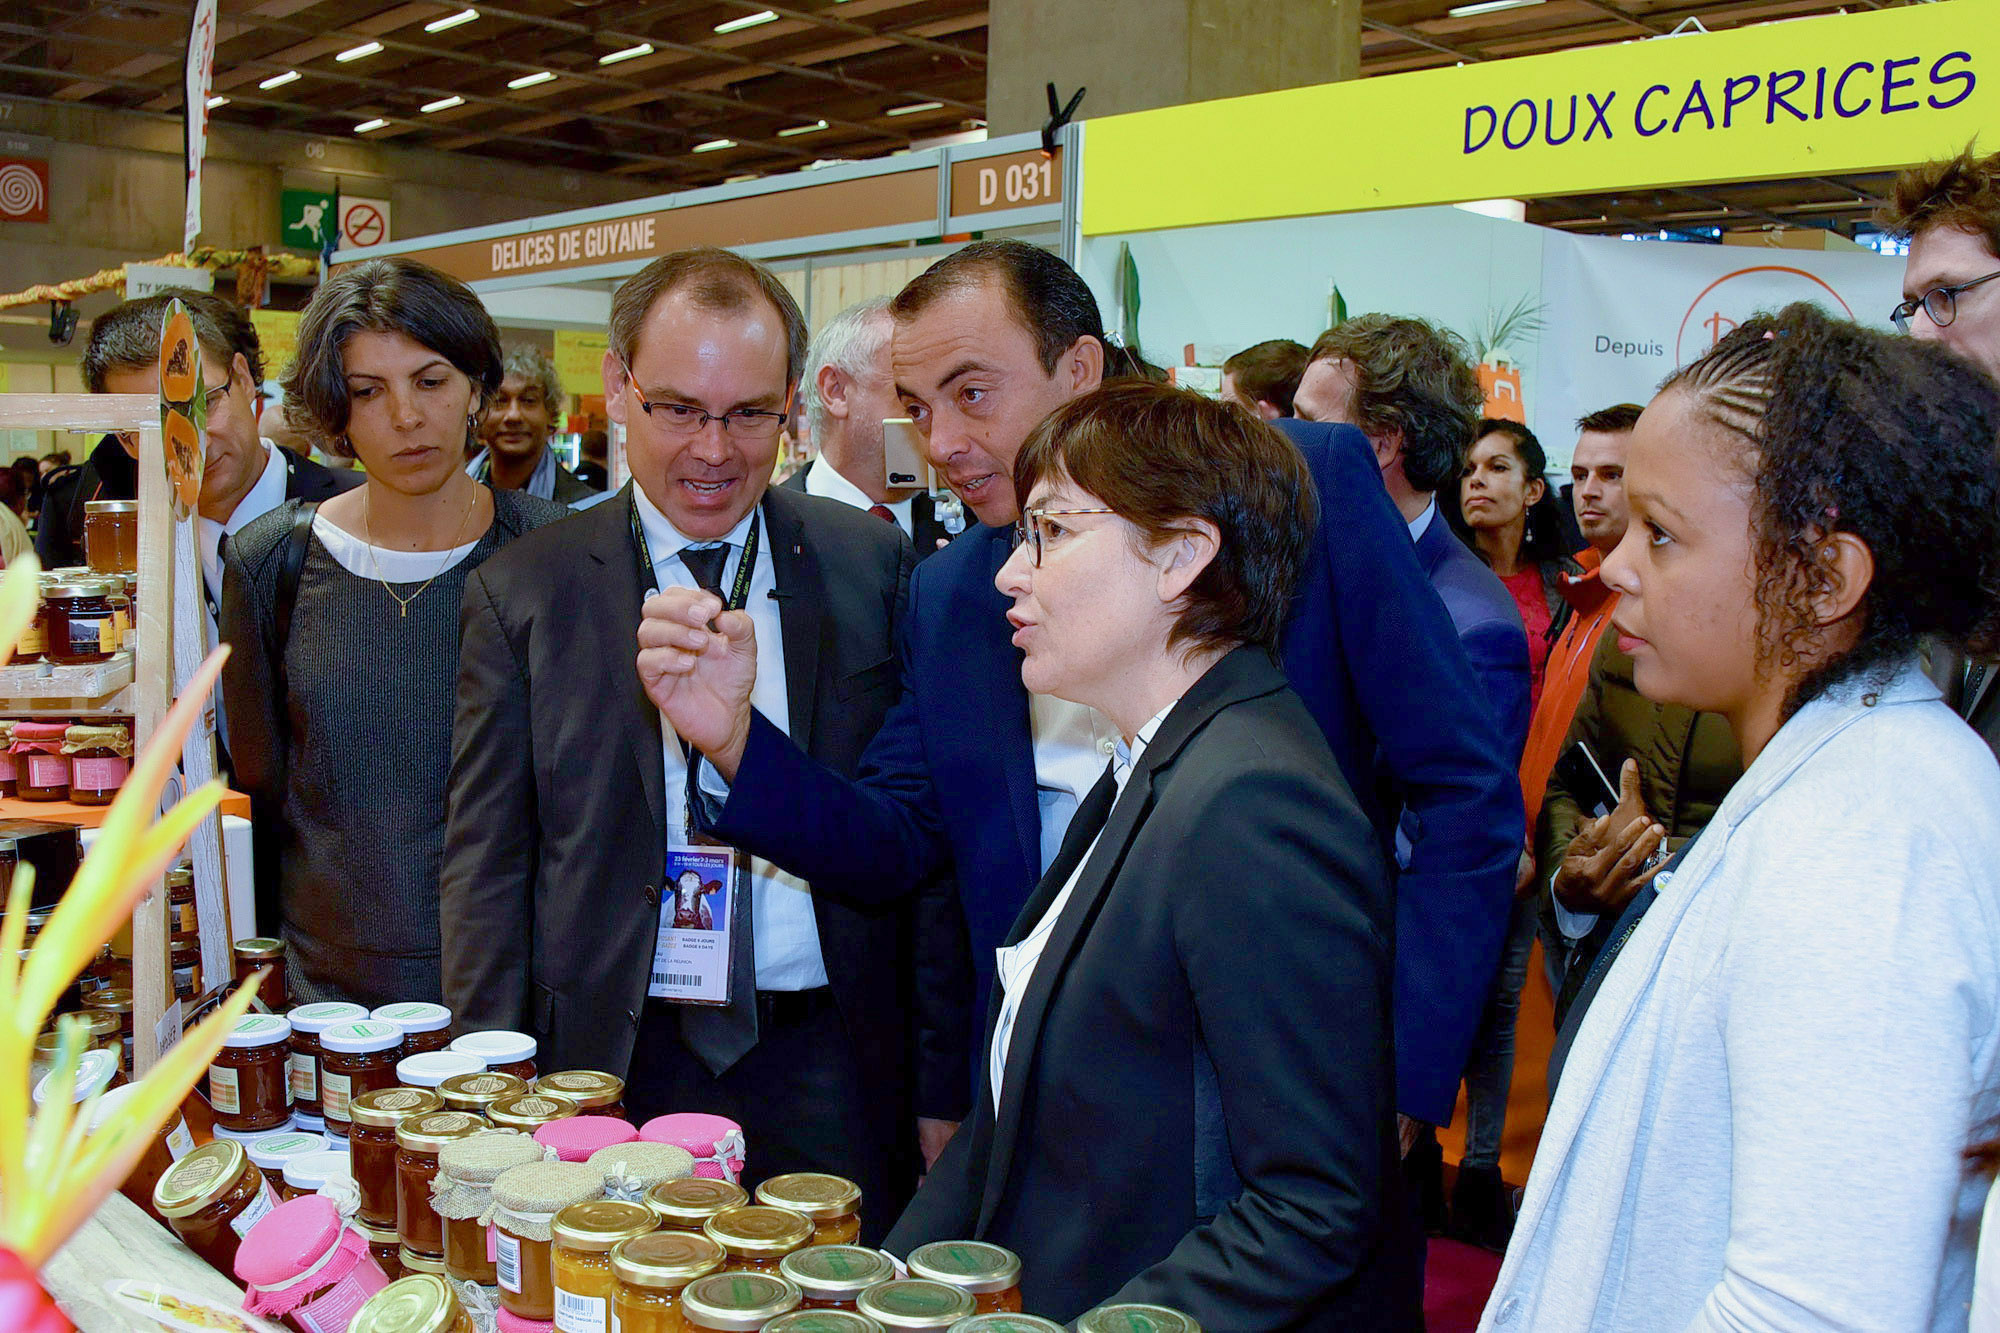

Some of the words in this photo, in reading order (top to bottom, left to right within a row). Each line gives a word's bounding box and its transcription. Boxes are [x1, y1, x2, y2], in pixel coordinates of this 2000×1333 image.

[1463, 90, 1617, 155] DOUX
[1634, 50, 1977, 138] CAPRICES
[979, 167, 998, 206] D
[1005, 160, 1052, 202] 031
[491, 234, 555, 272] DELICES
[558, 229, 581, 262] DE
[584, 218, 656, 258] GUYANE
[1594, 335, 1664, 358] Depuis
